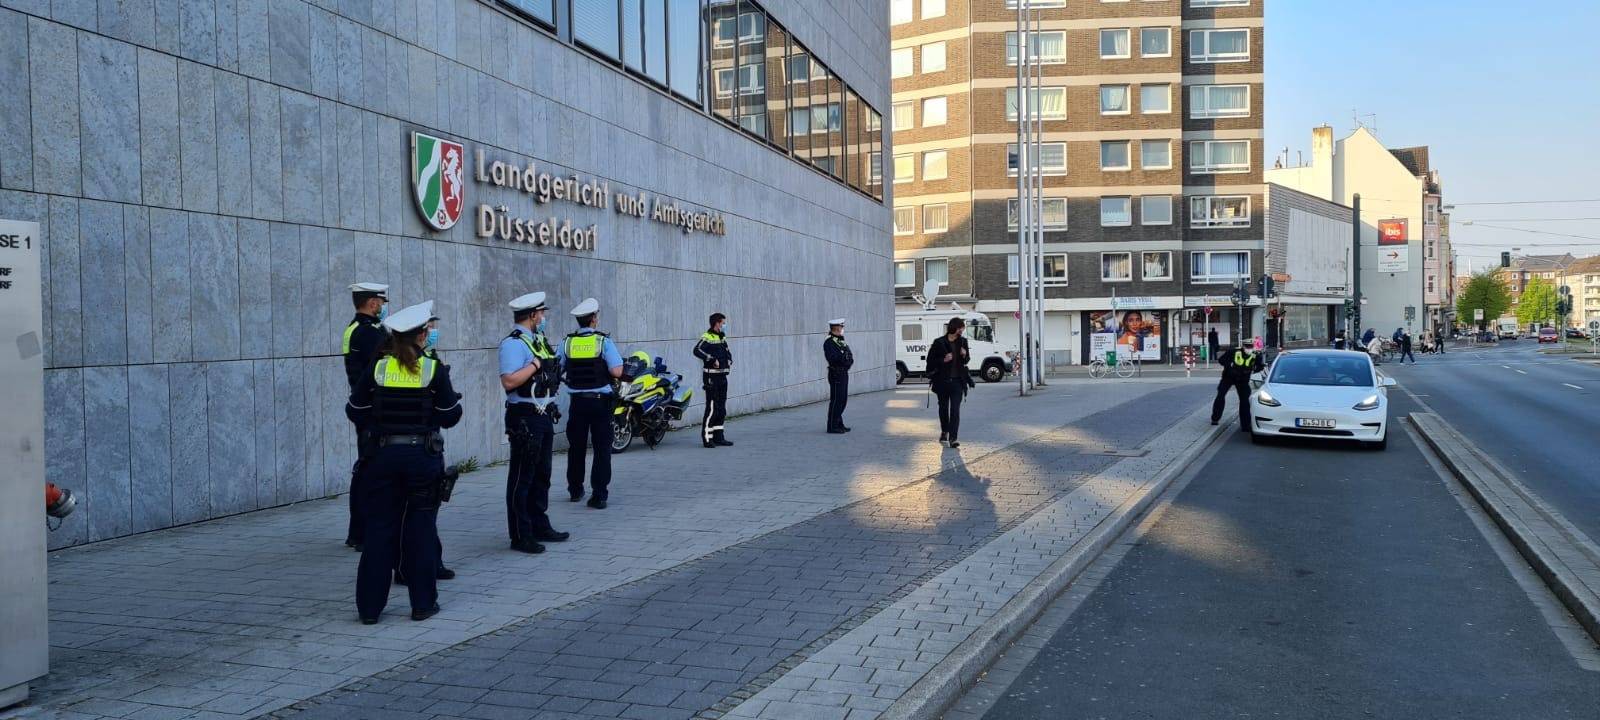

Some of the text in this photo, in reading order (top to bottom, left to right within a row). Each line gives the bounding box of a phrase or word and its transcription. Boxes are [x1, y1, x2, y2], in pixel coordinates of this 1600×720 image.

[476, 148, 727, 237] Landgericht und Amtsgericht
[479, 204, 598, 251] Düsseldorf
[1385, 228, 1401, 236] ibis
[24, 235, 31, 250] 1
[906, 344, 927, 353] WDR
